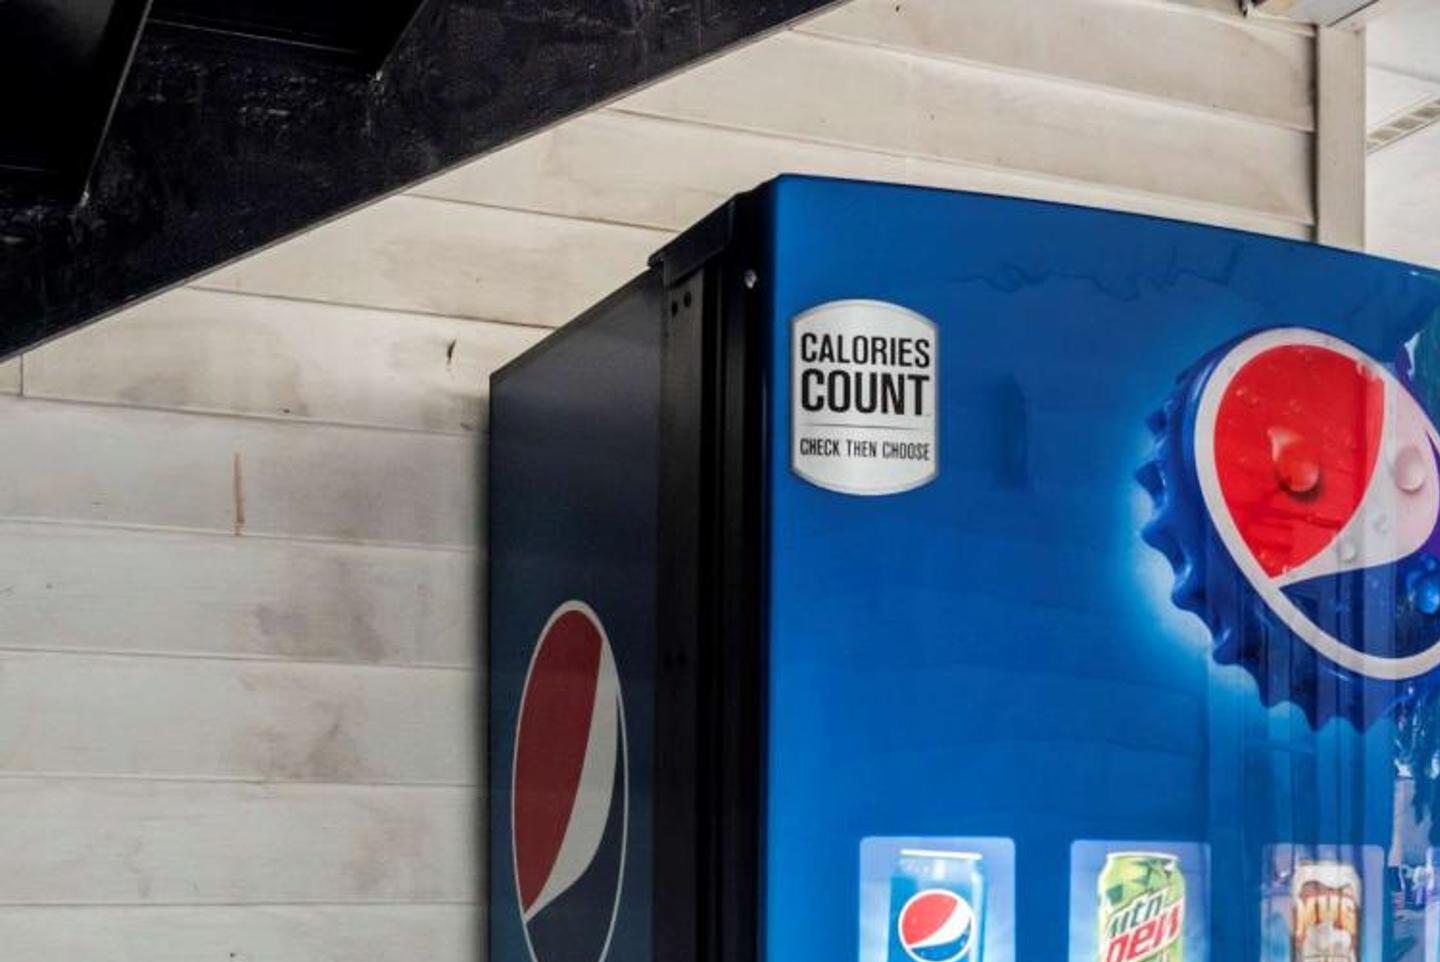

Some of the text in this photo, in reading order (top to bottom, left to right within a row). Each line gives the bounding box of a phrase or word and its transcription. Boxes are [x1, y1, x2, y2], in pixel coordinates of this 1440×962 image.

[800, 332, 931, 369] CALORIES
[800, 368, 931, 417] COUNT
[800, 437, 931, 462] CHECK THEN CHOOSE
